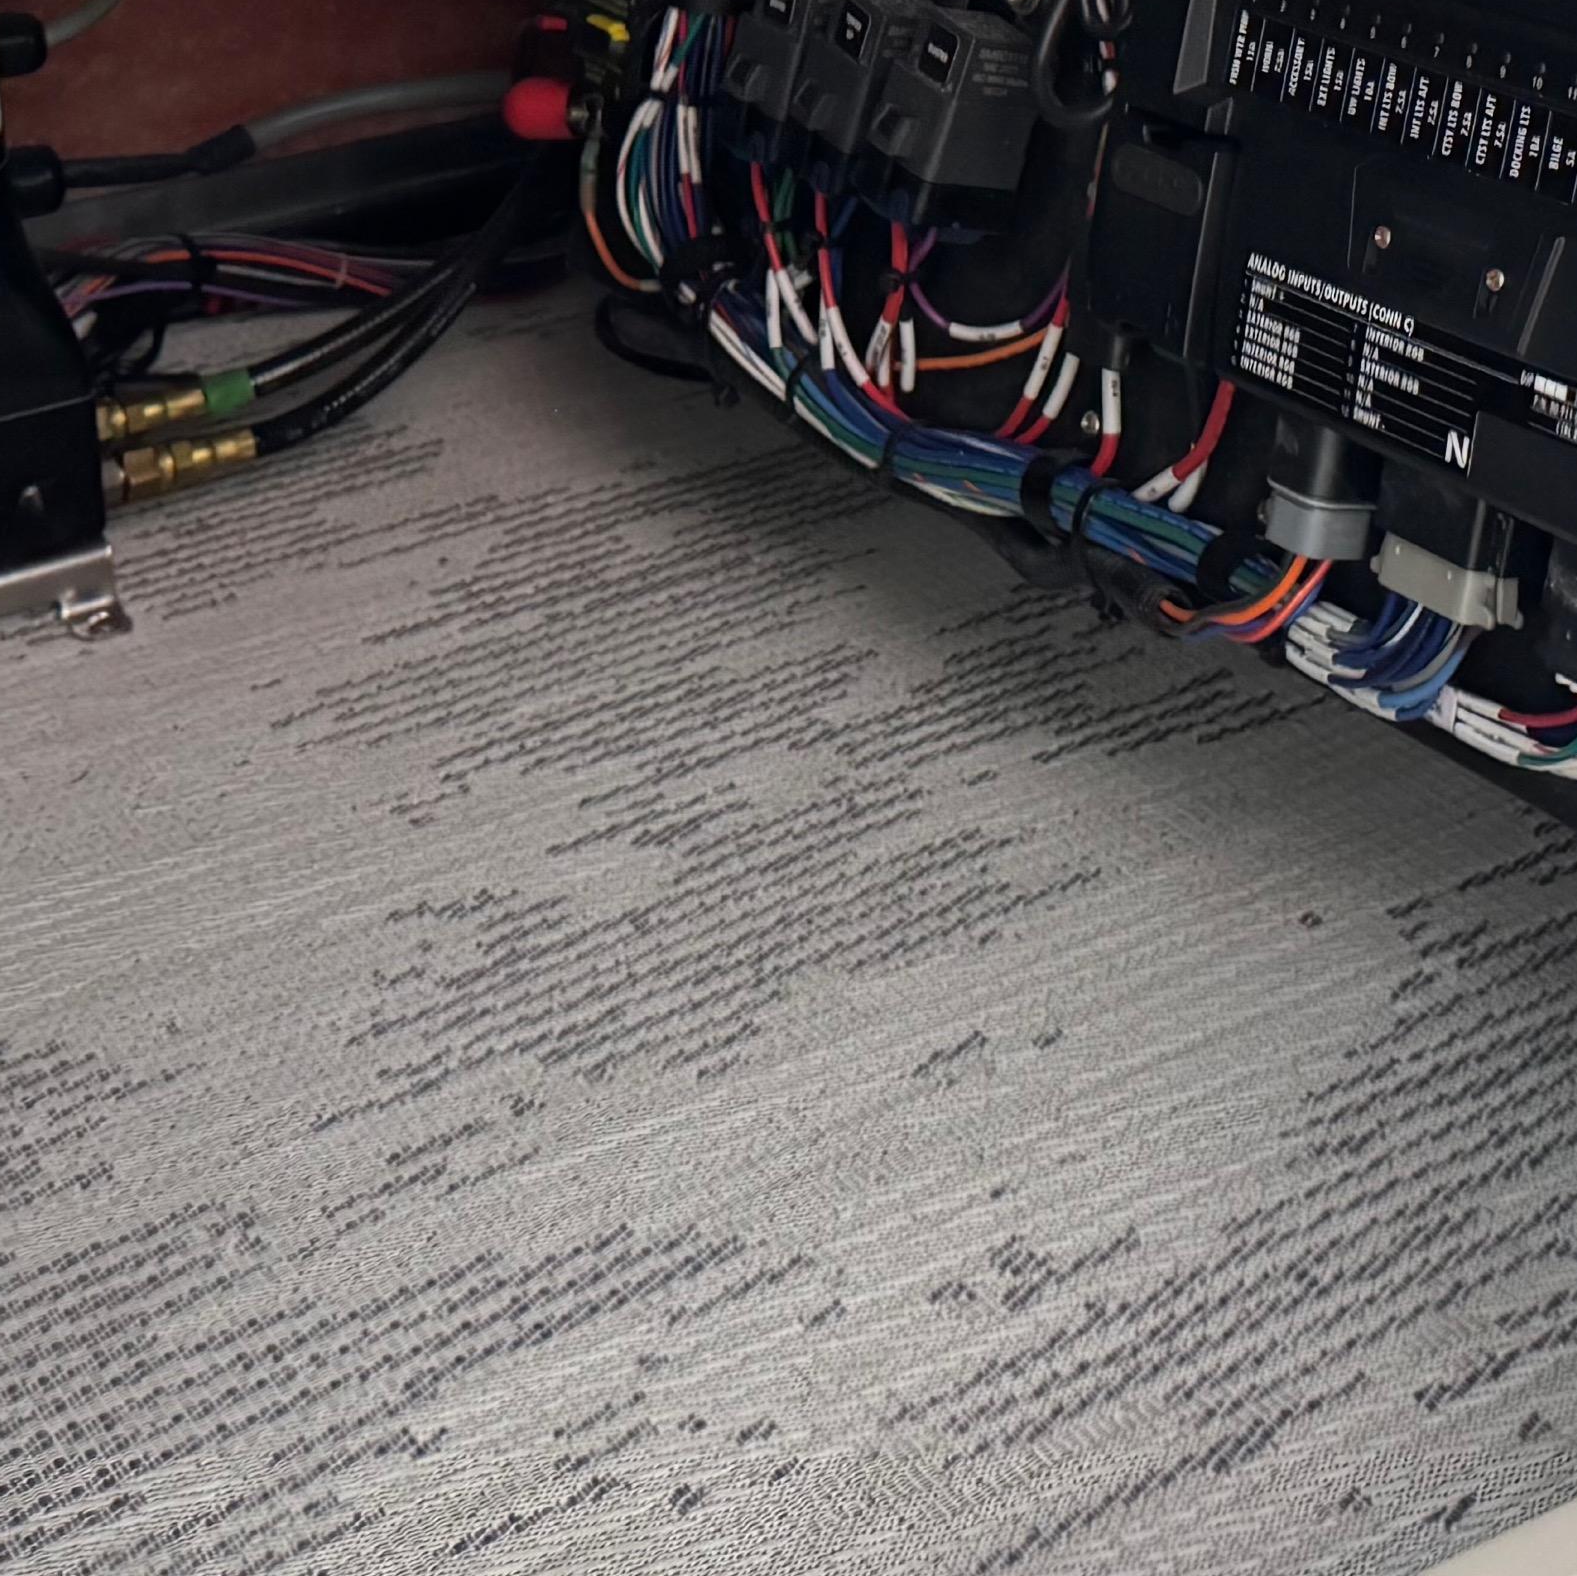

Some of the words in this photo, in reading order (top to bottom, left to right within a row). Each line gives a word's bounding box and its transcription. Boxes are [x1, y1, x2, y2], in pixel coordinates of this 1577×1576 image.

[1418, 76, 1430, 99] AFT
[1485, 94, 1497, 118] AFT
[1509, 126, 1528, 179] DOCKING
[1520, 105, 1532, 127] LTS
[1548, 136, 1564, 171] BILGE
[1247, 252, 1286, 281] ANALOG
[1287, 269, 1369, 317] INPUTS/OUTPUTS
[1369, 301, 1402, 329] (CONN
[1365, 326, 1406, 352] INTERIOR
[1444, 429, 1470, 469] N
